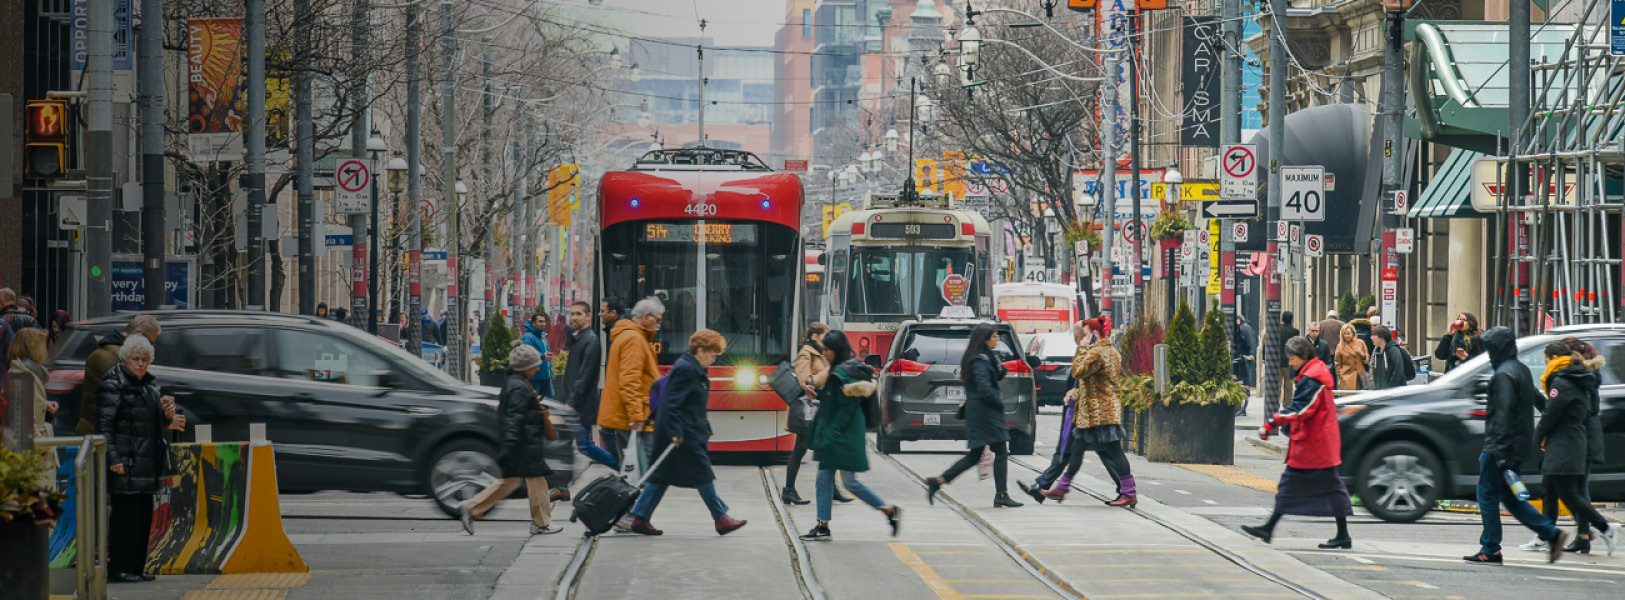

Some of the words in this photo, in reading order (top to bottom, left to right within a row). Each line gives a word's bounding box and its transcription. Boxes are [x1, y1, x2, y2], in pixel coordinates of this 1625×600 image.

[190, 25, 203, 83] BEAUTY
[1193, 26, 1211, 139] CARISMA
[1285, 174, 1320, 182] MAXIMUM
[1156, 186, 1193, 198] PK
[1285, 190, 1321, 214] 40
[685, 203, 717, 216] 4420
[647, 224, 669, 239] 514
[905, 225, 920, 234] 503
[1026, 271, 1045, 282] 40
[112, 281, 138, 291] very
